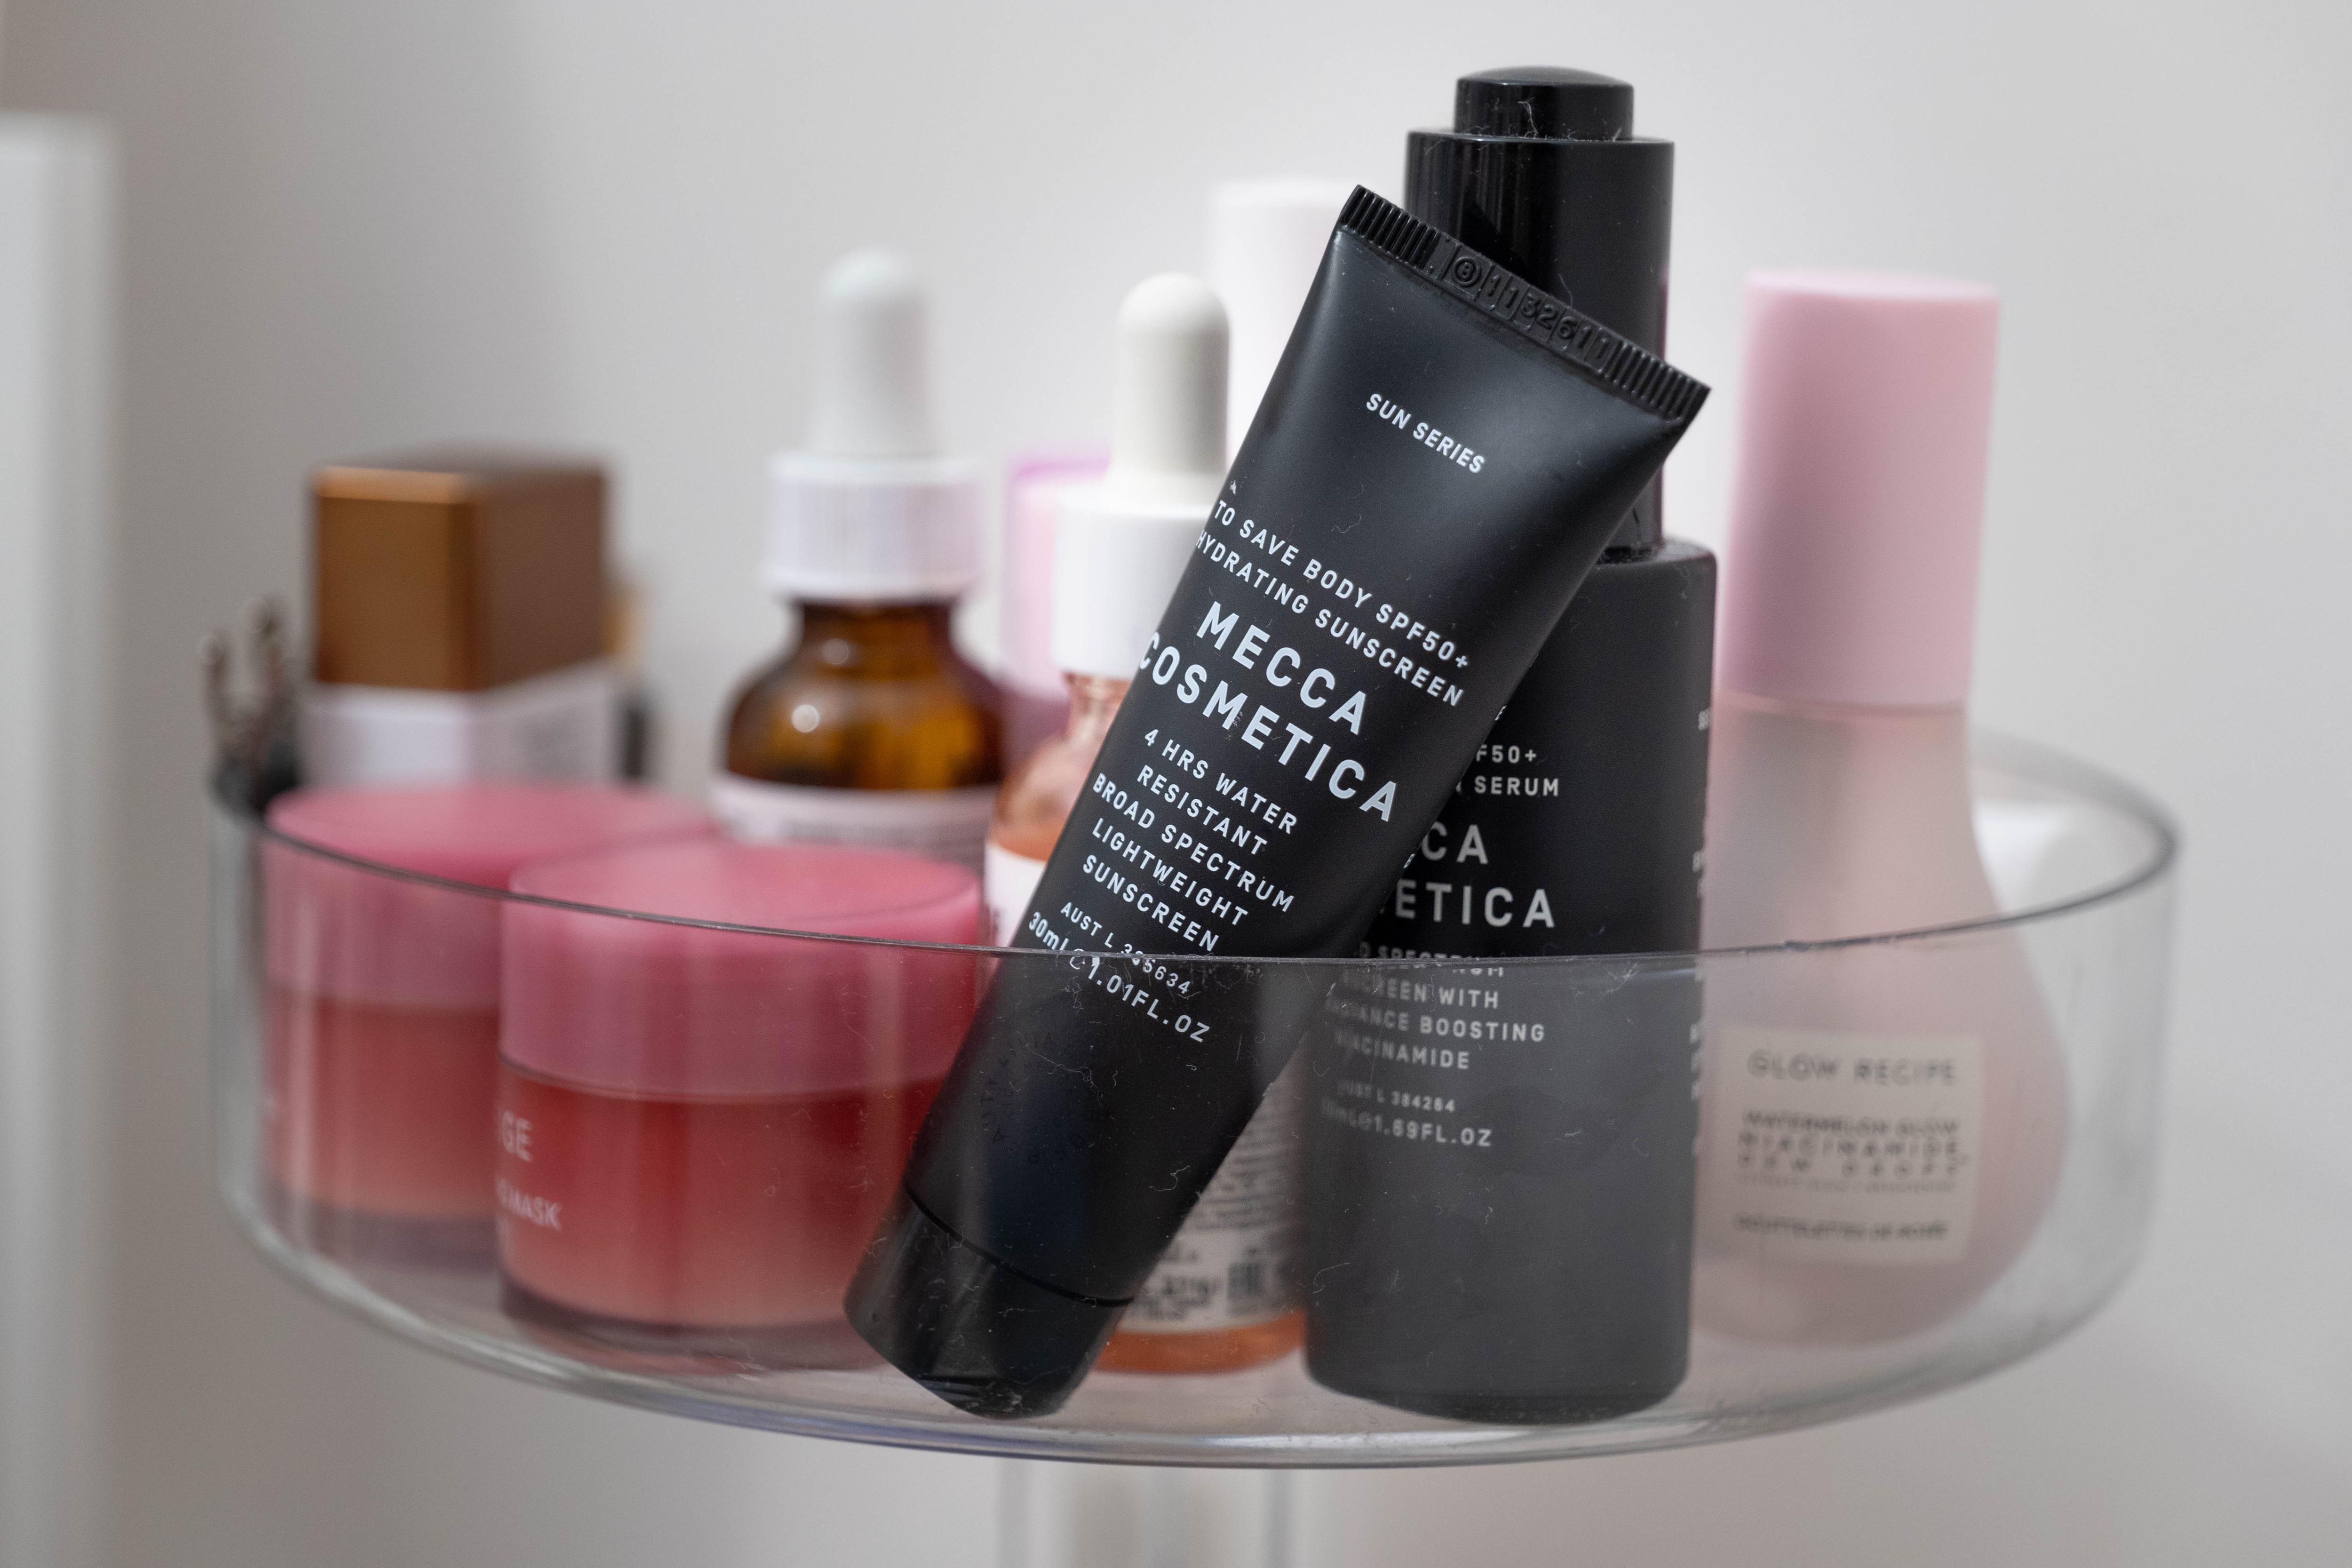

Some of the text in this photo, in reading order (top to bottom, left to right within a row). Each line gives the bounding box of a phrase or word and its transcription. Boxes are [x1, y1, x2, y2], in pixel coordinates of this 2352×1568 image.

[1366, 393, 1486, 474] SUN SERIES
[1195, 528, 1463, 707] HYDRATING SUNSCREEN
[1214, 499, 1468, 668] TO SAVE BODY SPF50+
[1195, 600, 1367, 736] MECCA
[1138, 631, 1397, 822] COSMETICA
[1475, 744, 1538, 764] F50+
[1136, 764, 1268, 855] RESISTANT
[1144, 728, 1297, 835] 4 HRS WATER
[1474, 775, 1559, 797] SERUM
[1091, 817, 1249, 926] LIGHTWEIGHT
[1092, 772, 1295, 913] BROAD SPECTRUM
[1421, 821, 1489, 865] CA
[1060, 901, 1103, 937] AUST
[1104, 931, 1114, 949] L
[1082, 854, 1219, 952] SUNSCREEN
[1393, 877, 1556, 929] ETICA
[1419, 1014, 1546, 1044] BOOSTING
[1438, 987, 1499, 1010] WITH
[1747, 1049, 1839, 1081] GLOW
[500, 1109, 534, 1162] GE
